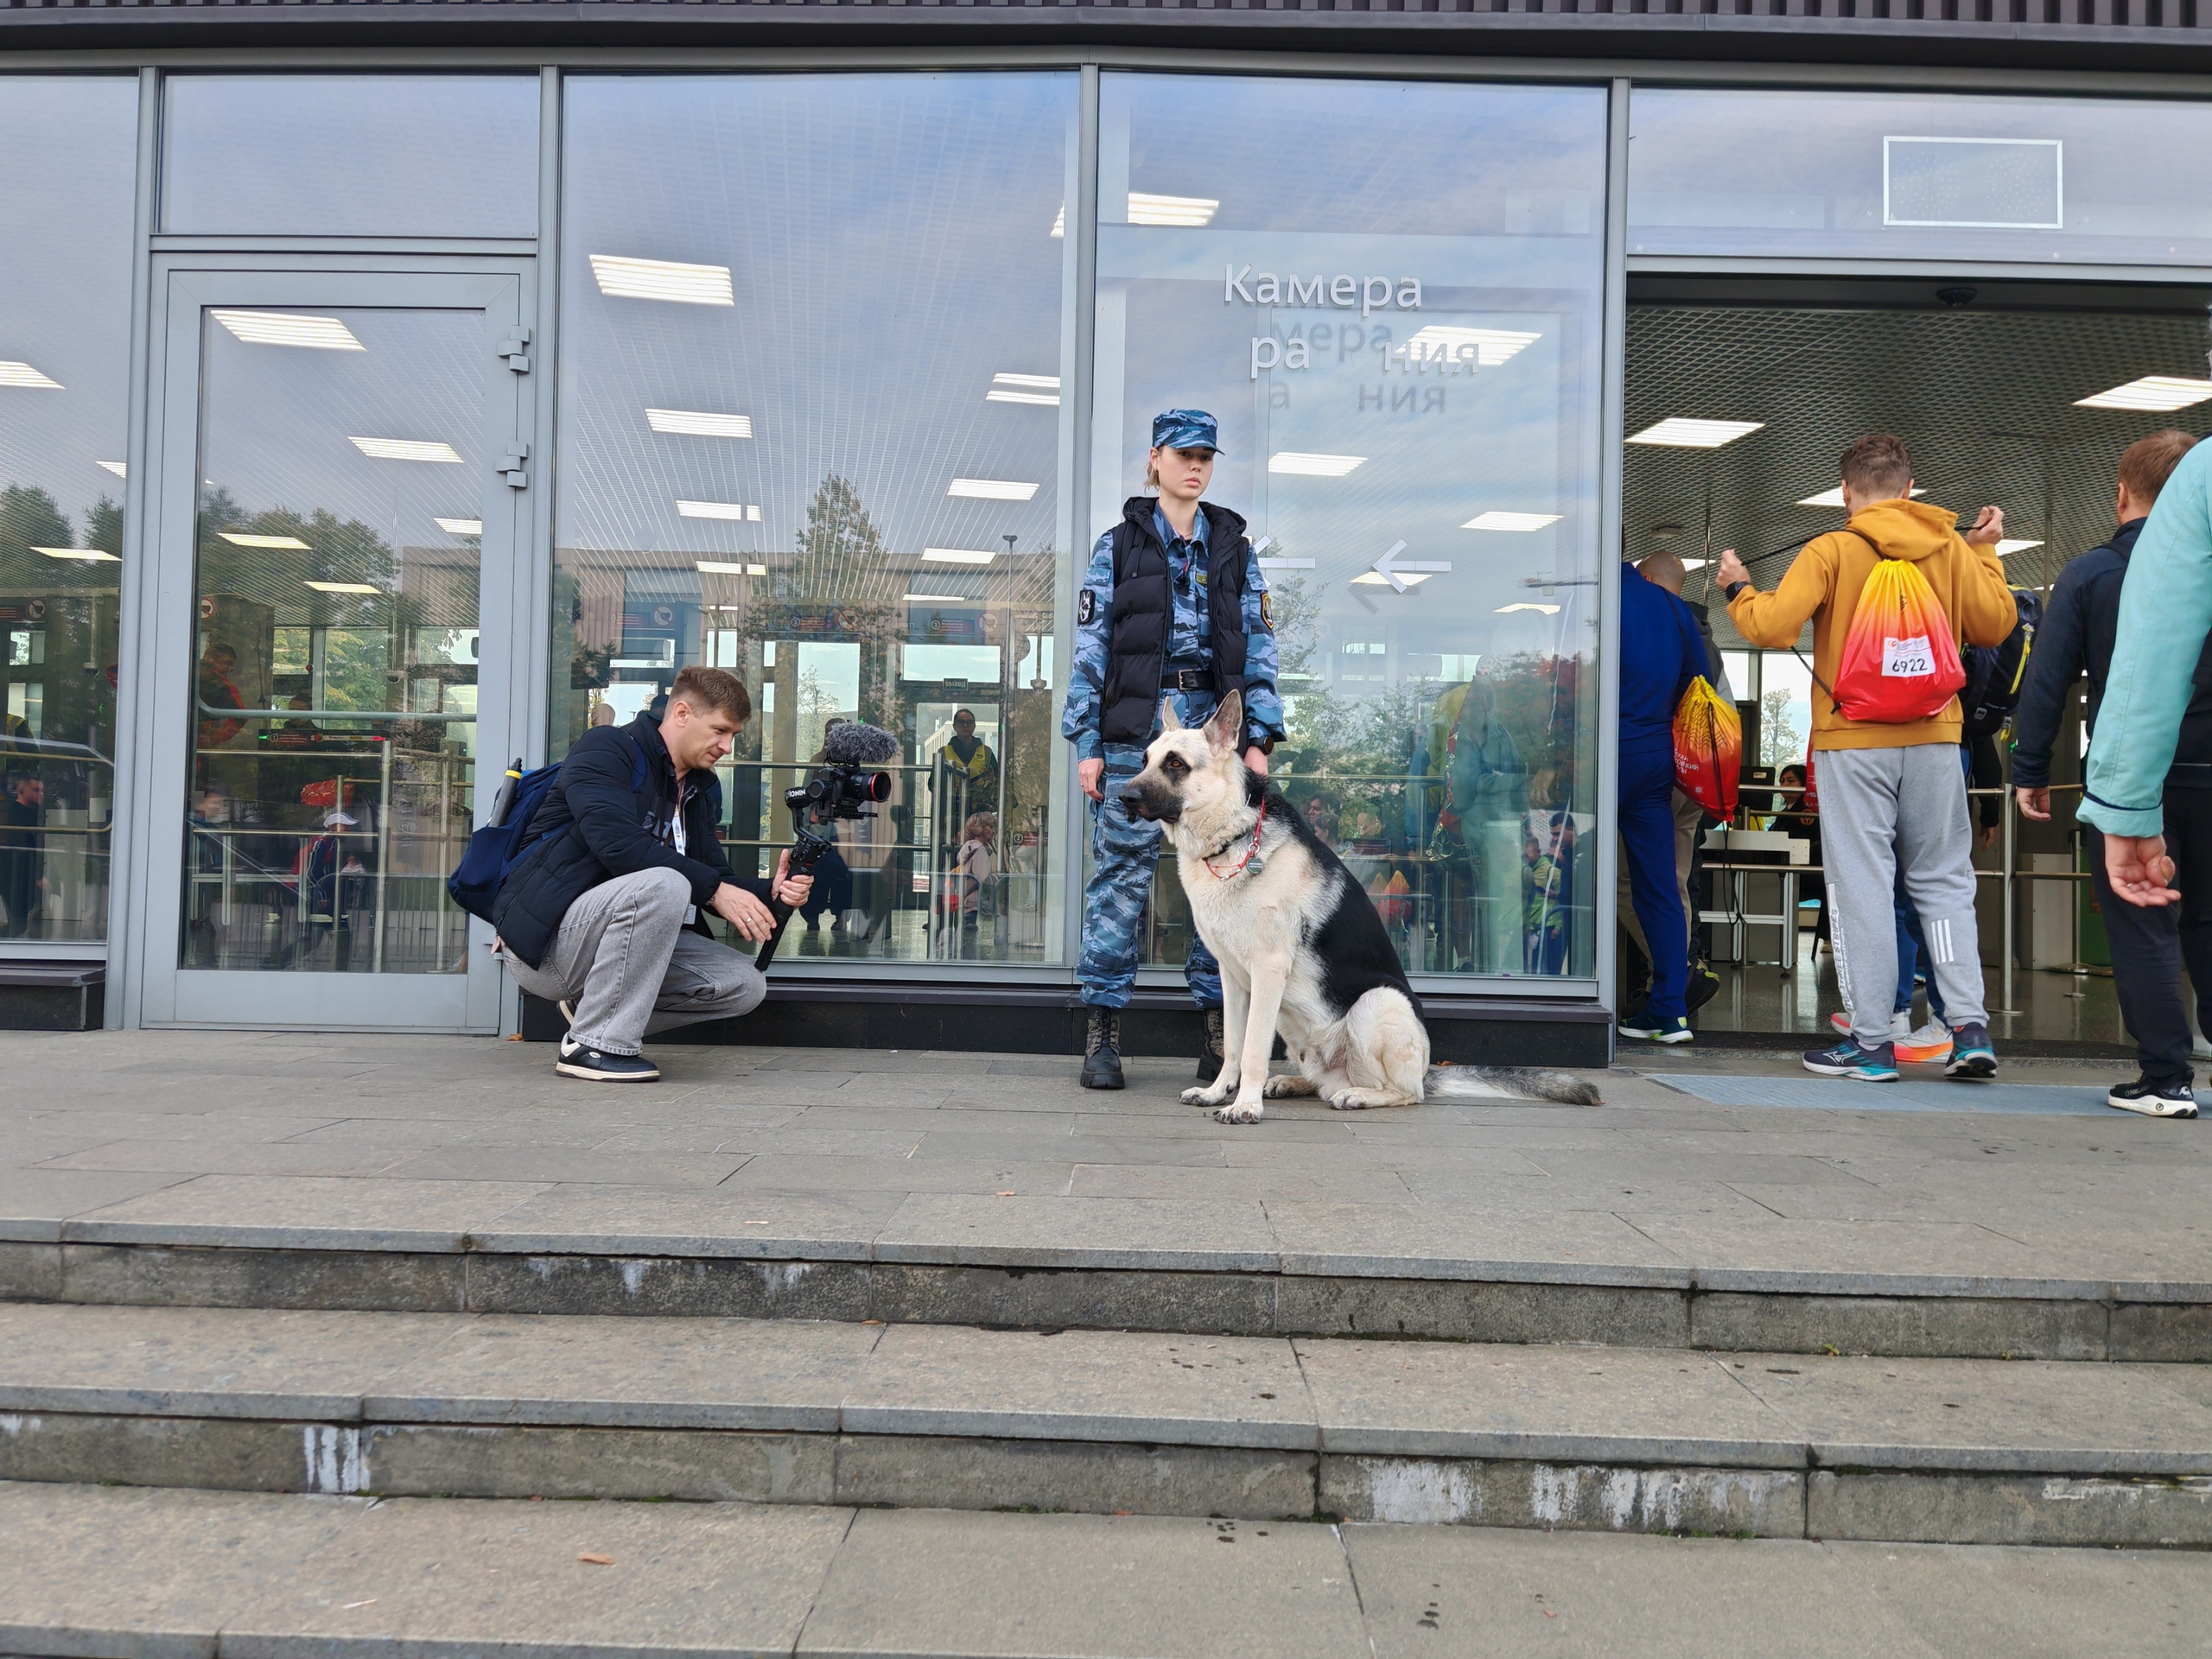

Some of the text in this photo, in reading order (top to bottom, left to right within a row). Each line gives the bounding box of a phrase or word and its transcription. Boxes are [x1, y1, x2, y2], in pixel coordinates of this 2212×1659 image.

[1224, 264, 1422, 318] Камера
[1892, 658, 1928, 673] 6922
[1831, 909, 1840, 954] STRIPES
